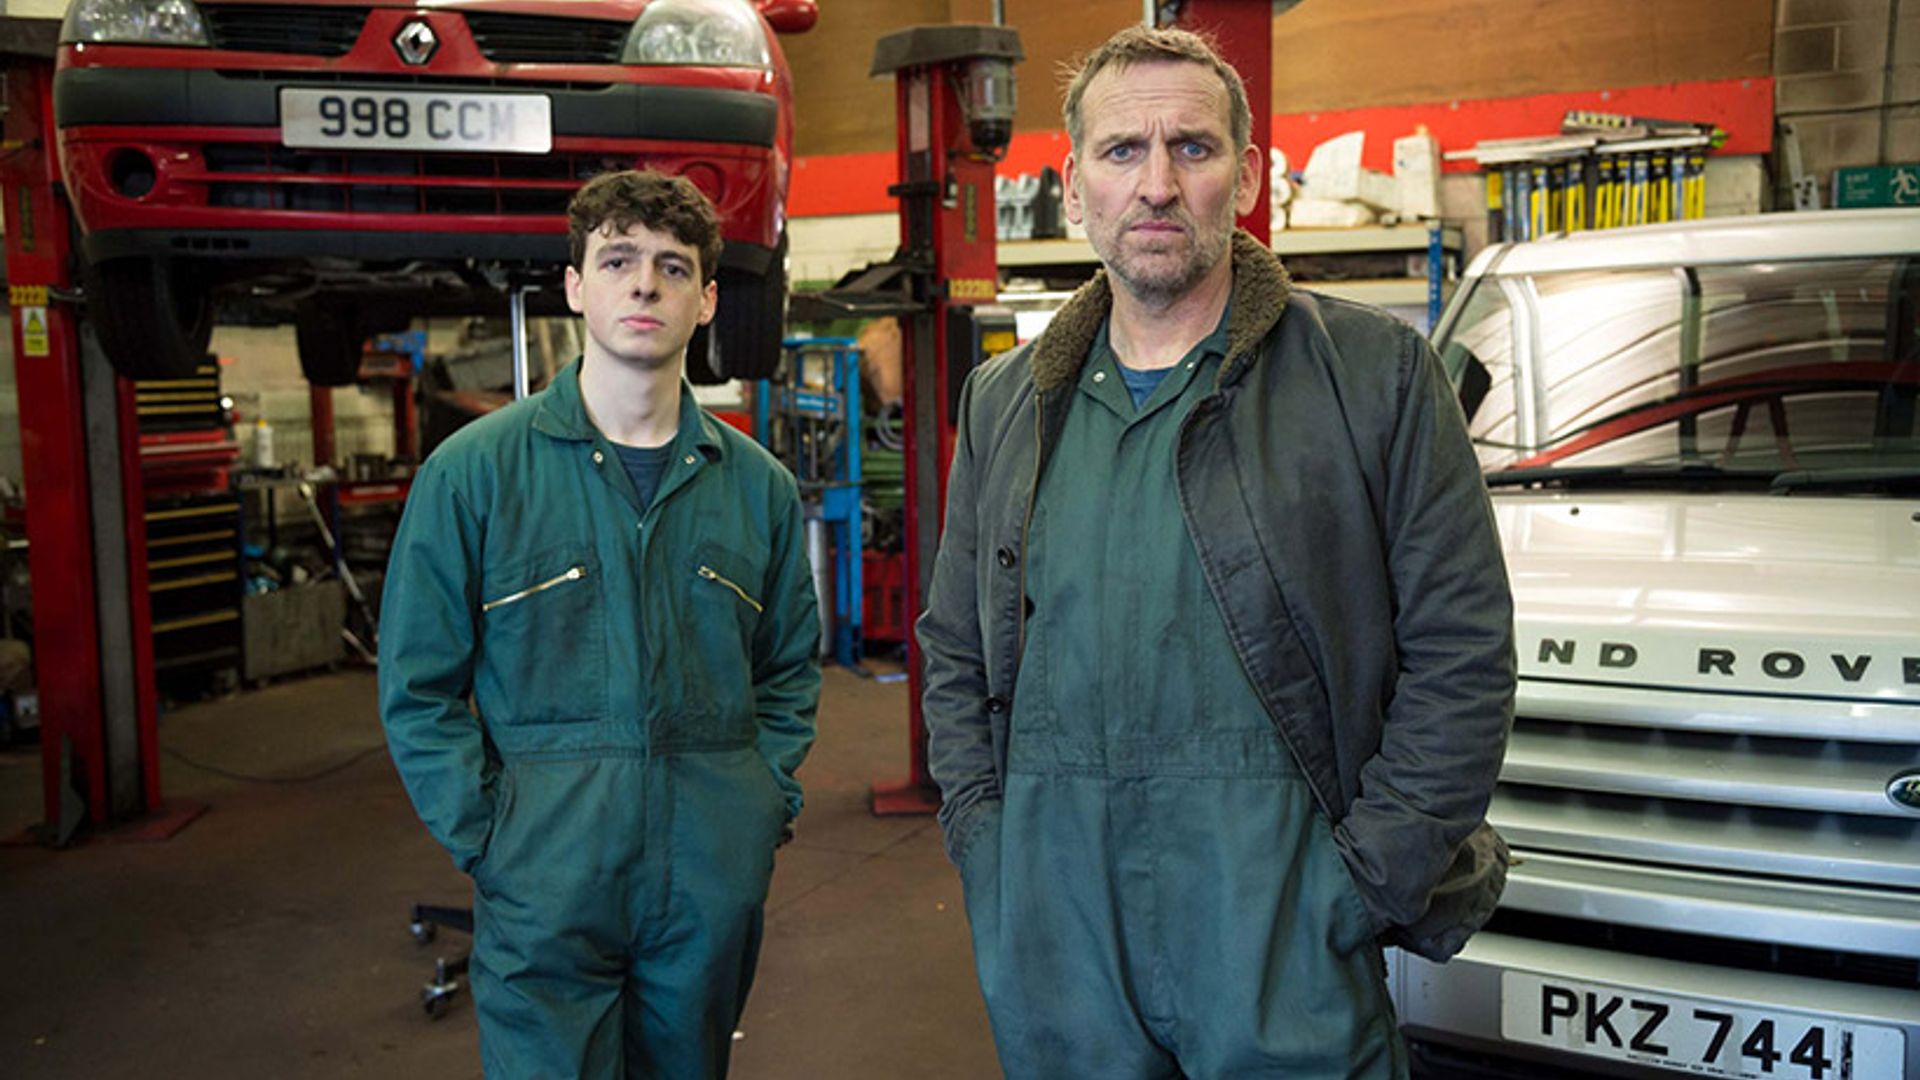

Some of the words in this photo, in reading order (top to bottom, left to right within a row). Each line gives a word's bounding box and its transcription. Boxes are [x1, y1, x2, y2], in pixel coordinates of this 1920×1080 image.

[319, 96, 411, 139] 998
[426, 99, 516, 143] CCM
[1538, 638, 1638, 669] ND
[1541, 984, 1670, 1056] PKZ
[1692, 1009, 1832, 1080] 744
